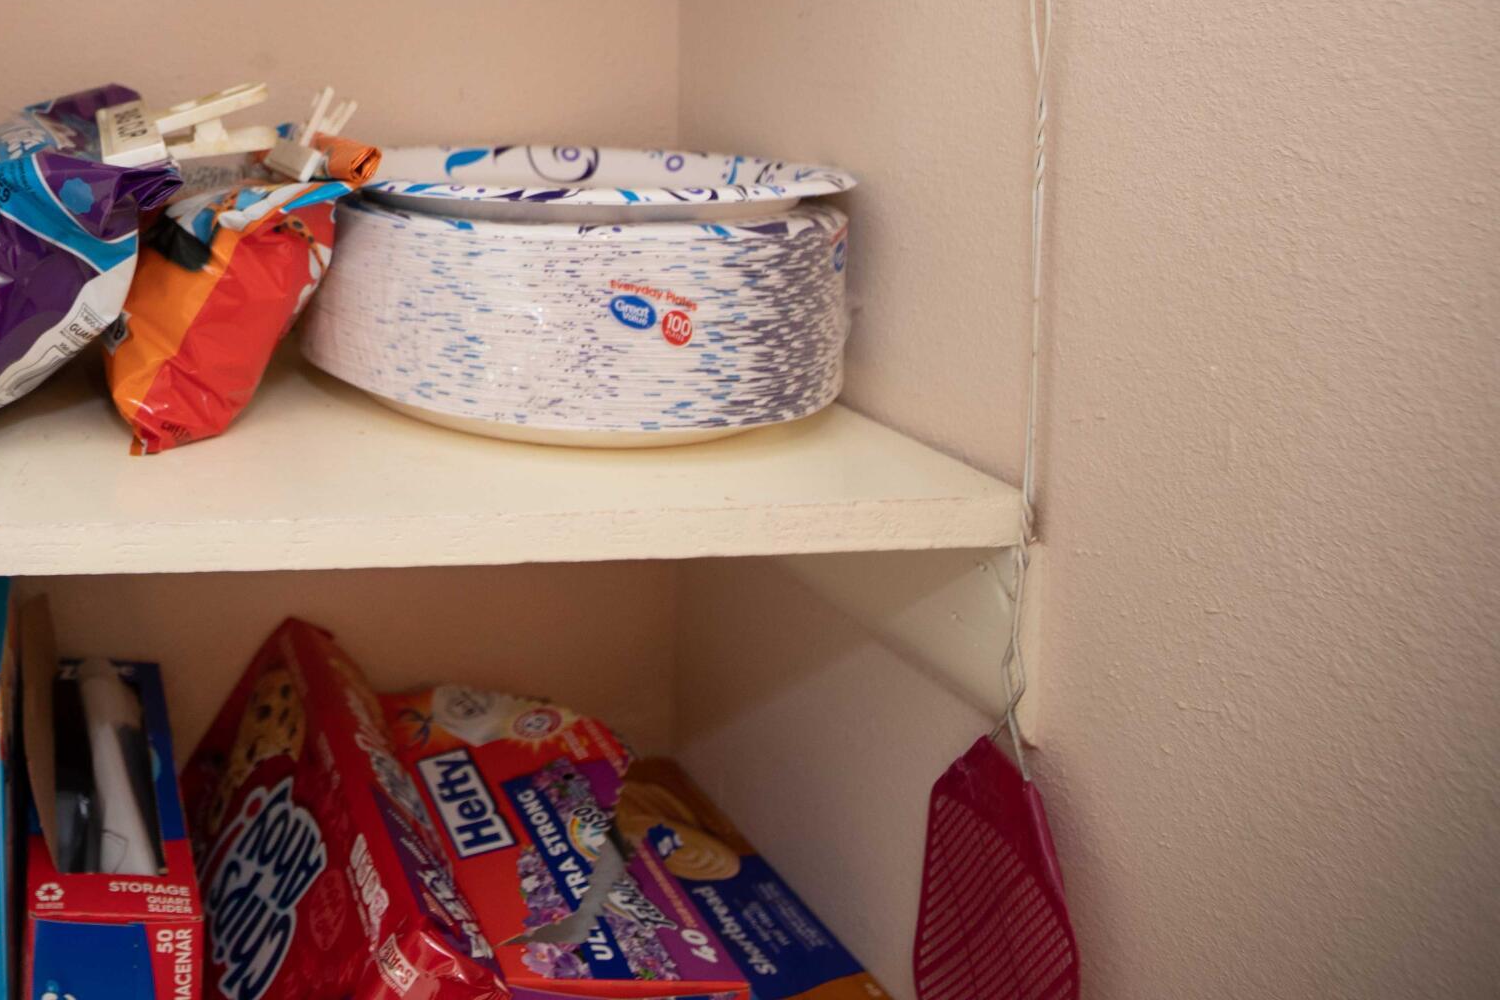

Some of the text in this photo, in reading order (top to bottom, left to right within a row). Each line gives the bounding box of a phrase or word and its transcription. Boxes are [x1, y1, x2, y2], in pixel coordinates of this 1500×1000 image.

[609, 280, 698, 311] Everyday Plates
[666, 312, 691, 336] 100
[436, 753, 502, 851] Hefty
[514, 789, 563, 858] STRONG
[108, 881, 191, 897] STORAGE
[146, 896, 192, 906] QUART
[147, 903, 193, 914] SLIDER
[155, 928, 174, 954] 50
[692, 885, 778, 977] Shortbread
[680, 930, 720, 964] 40
